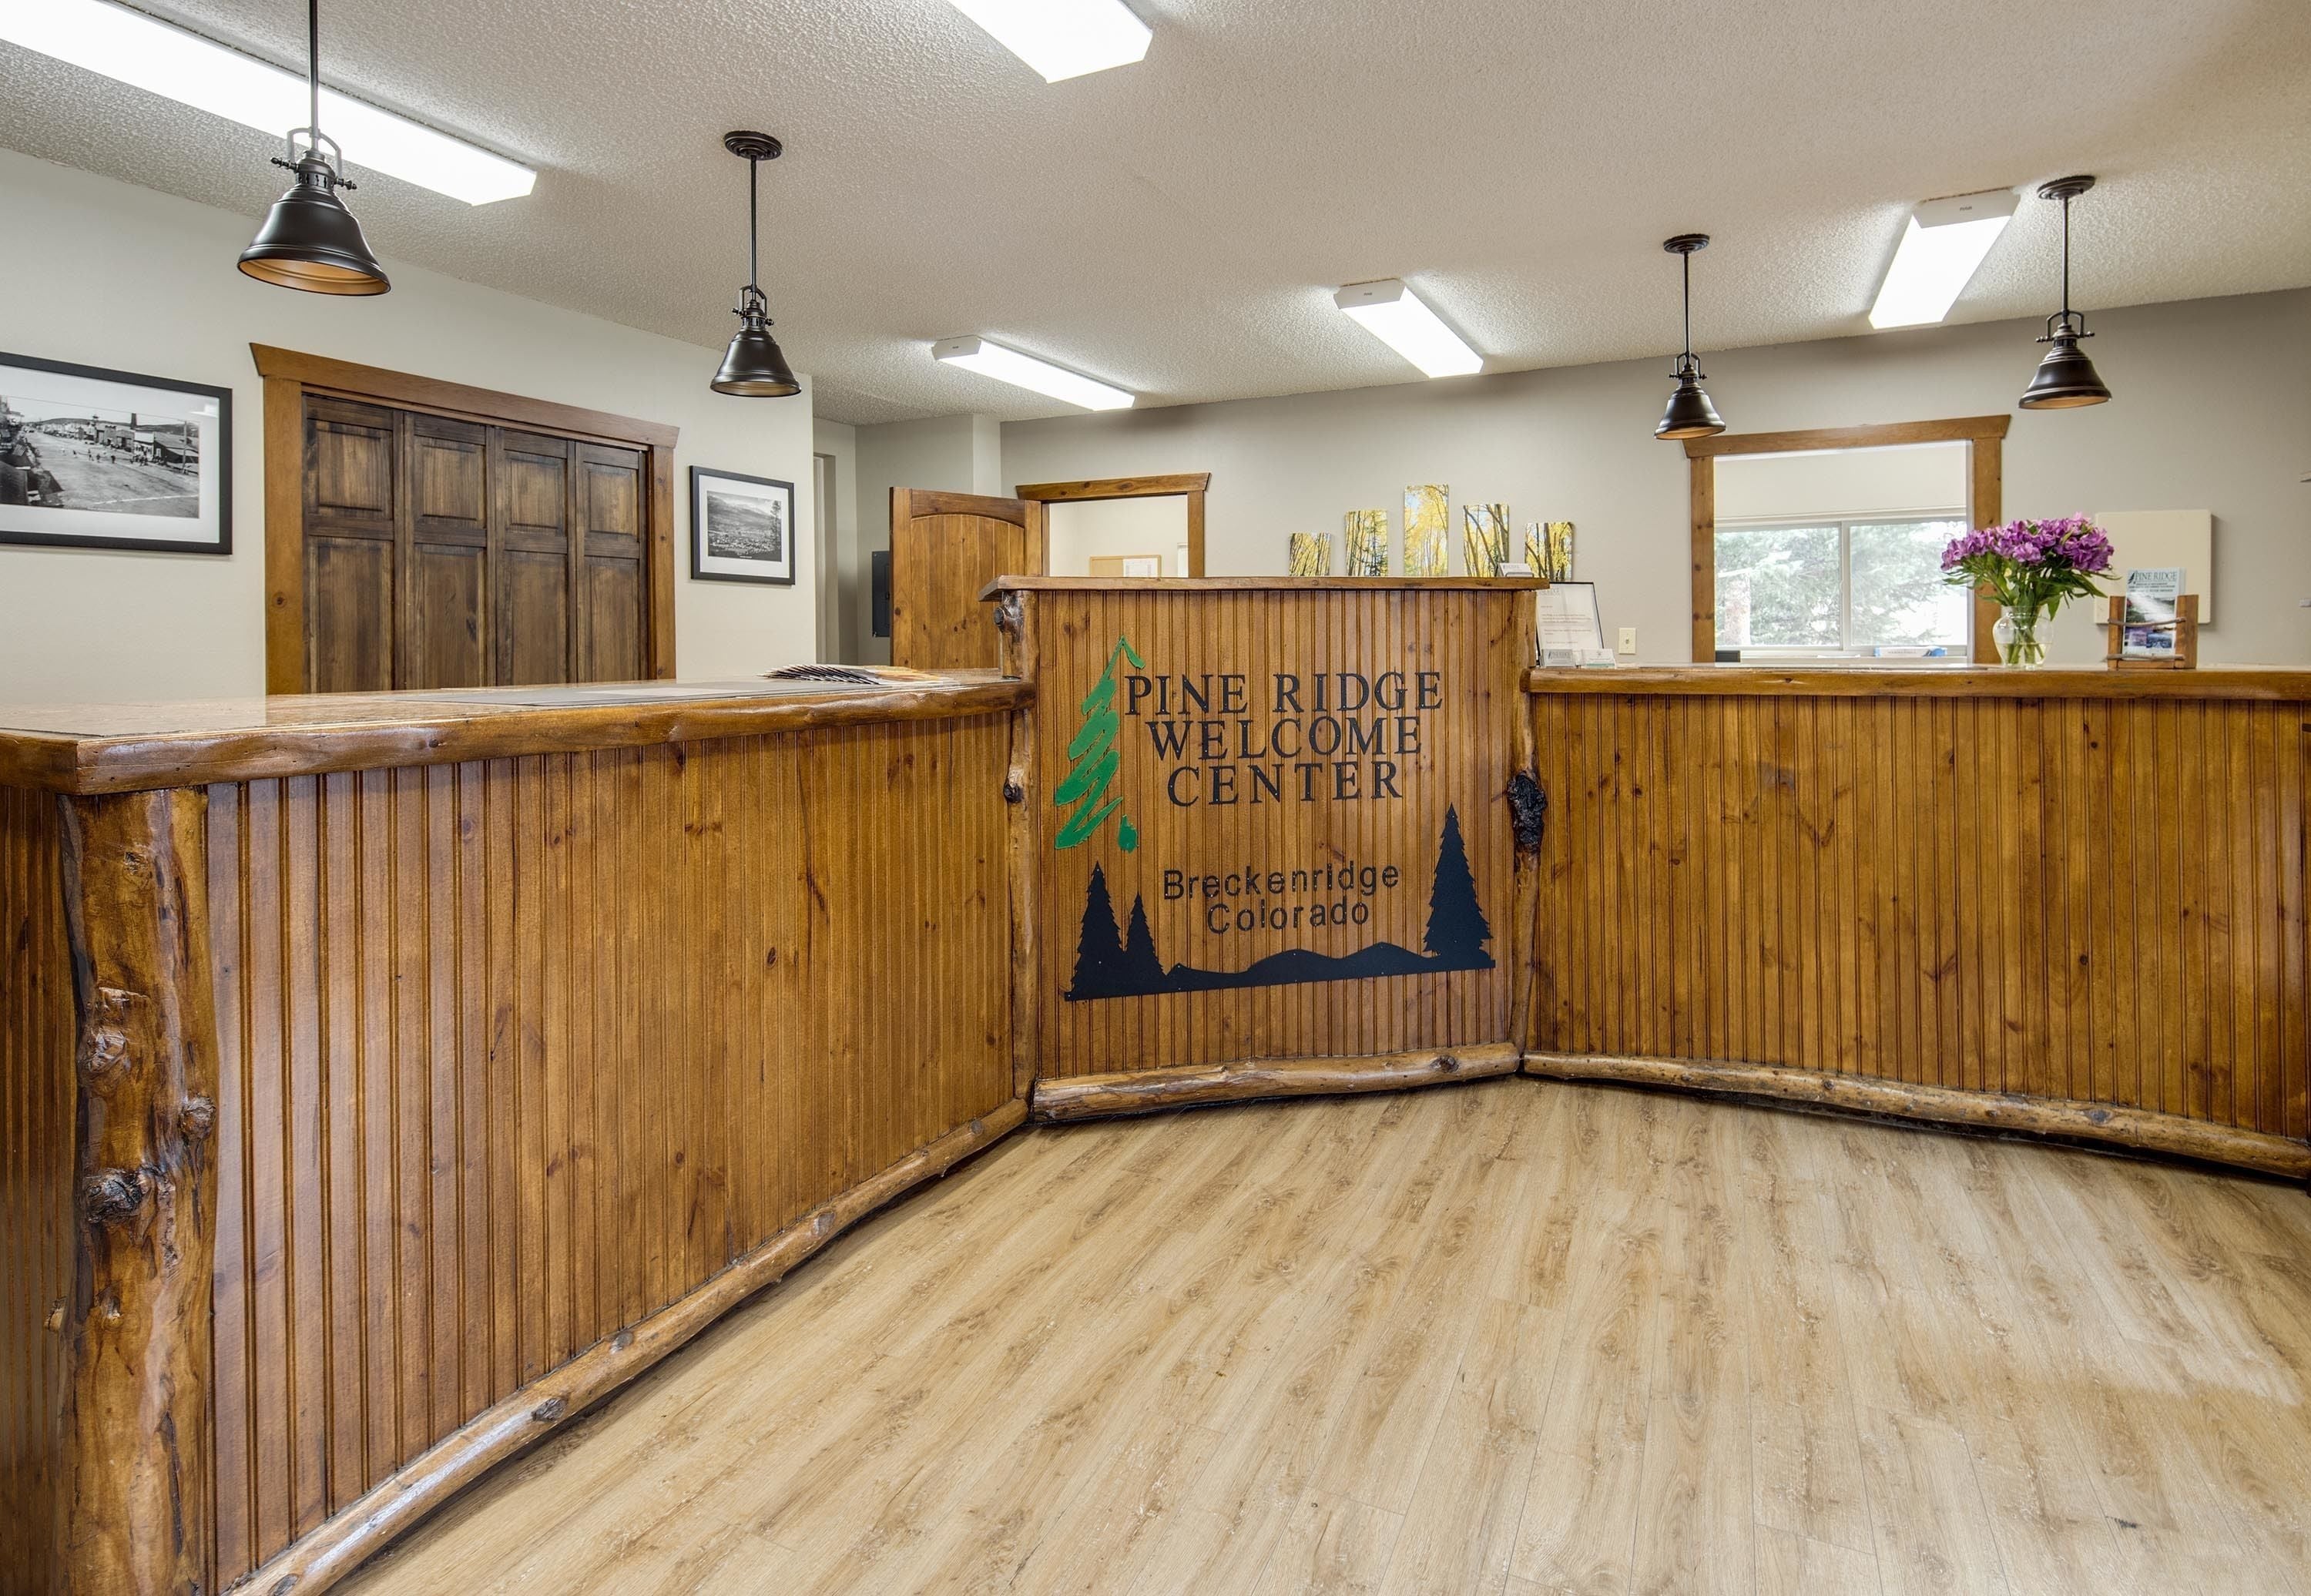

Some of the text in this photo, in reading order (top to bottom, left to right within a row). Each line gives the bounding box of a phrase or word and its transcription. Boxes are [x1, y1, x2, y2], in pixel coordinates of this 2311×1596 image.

[1125, 670, 1444, 716] PINE RIDGE
[1145, 716, 1423, 761] WELCOME
[1167, 760, 1403, 807] CENTER
[1163, 862, 1399, 900] Breckenridge
[1207, 897, 1370, 934] Colorado
